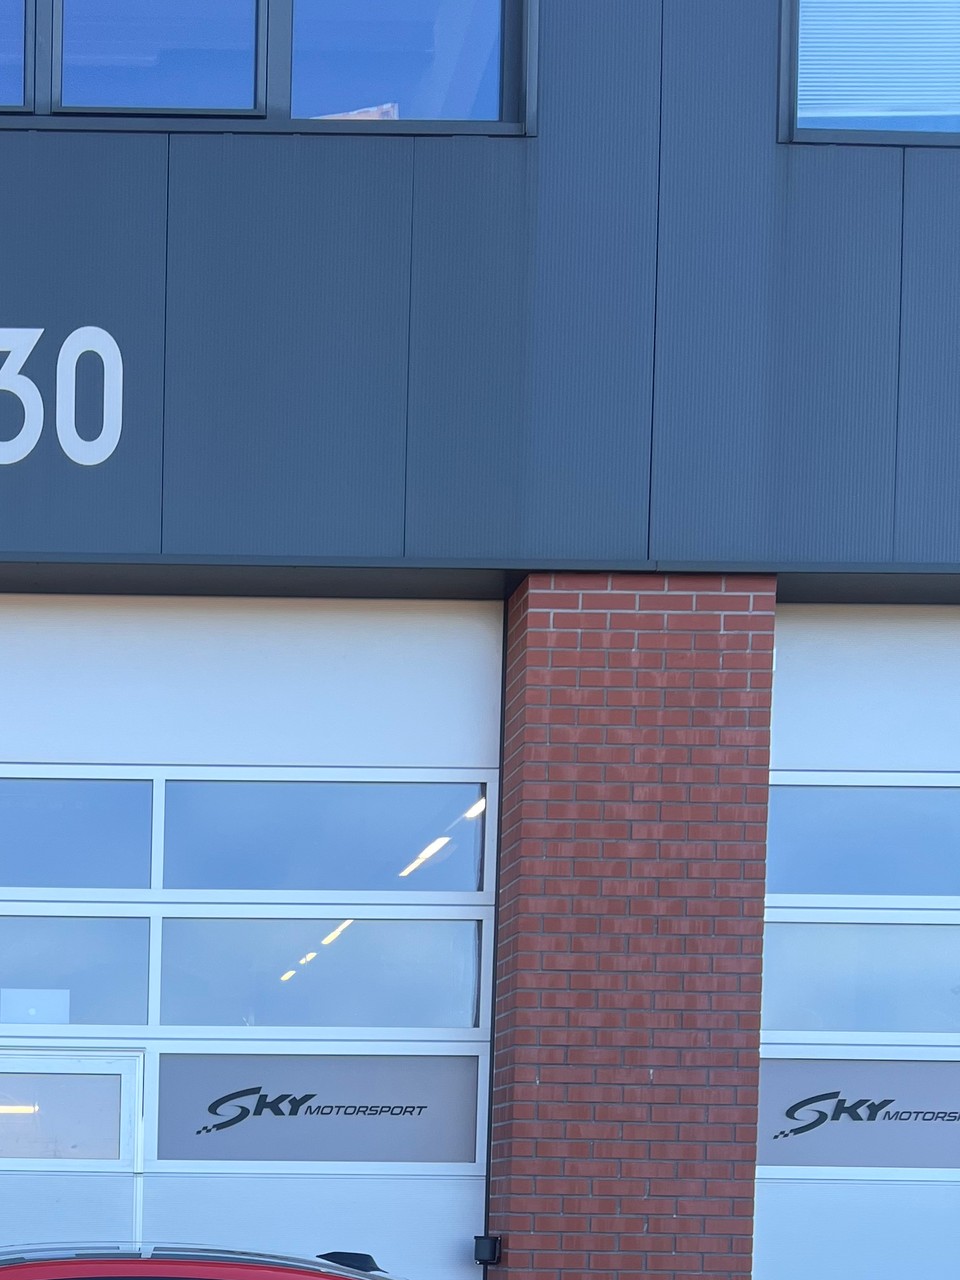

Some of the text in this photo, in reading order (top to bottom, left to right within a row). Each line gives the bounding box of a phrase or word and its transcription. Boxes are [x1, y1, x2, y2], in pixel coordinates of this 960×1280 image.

[195, 1086, 428, 1135] SKY MOTORSPORT
[773, 1091, 896, 1139] SKY
